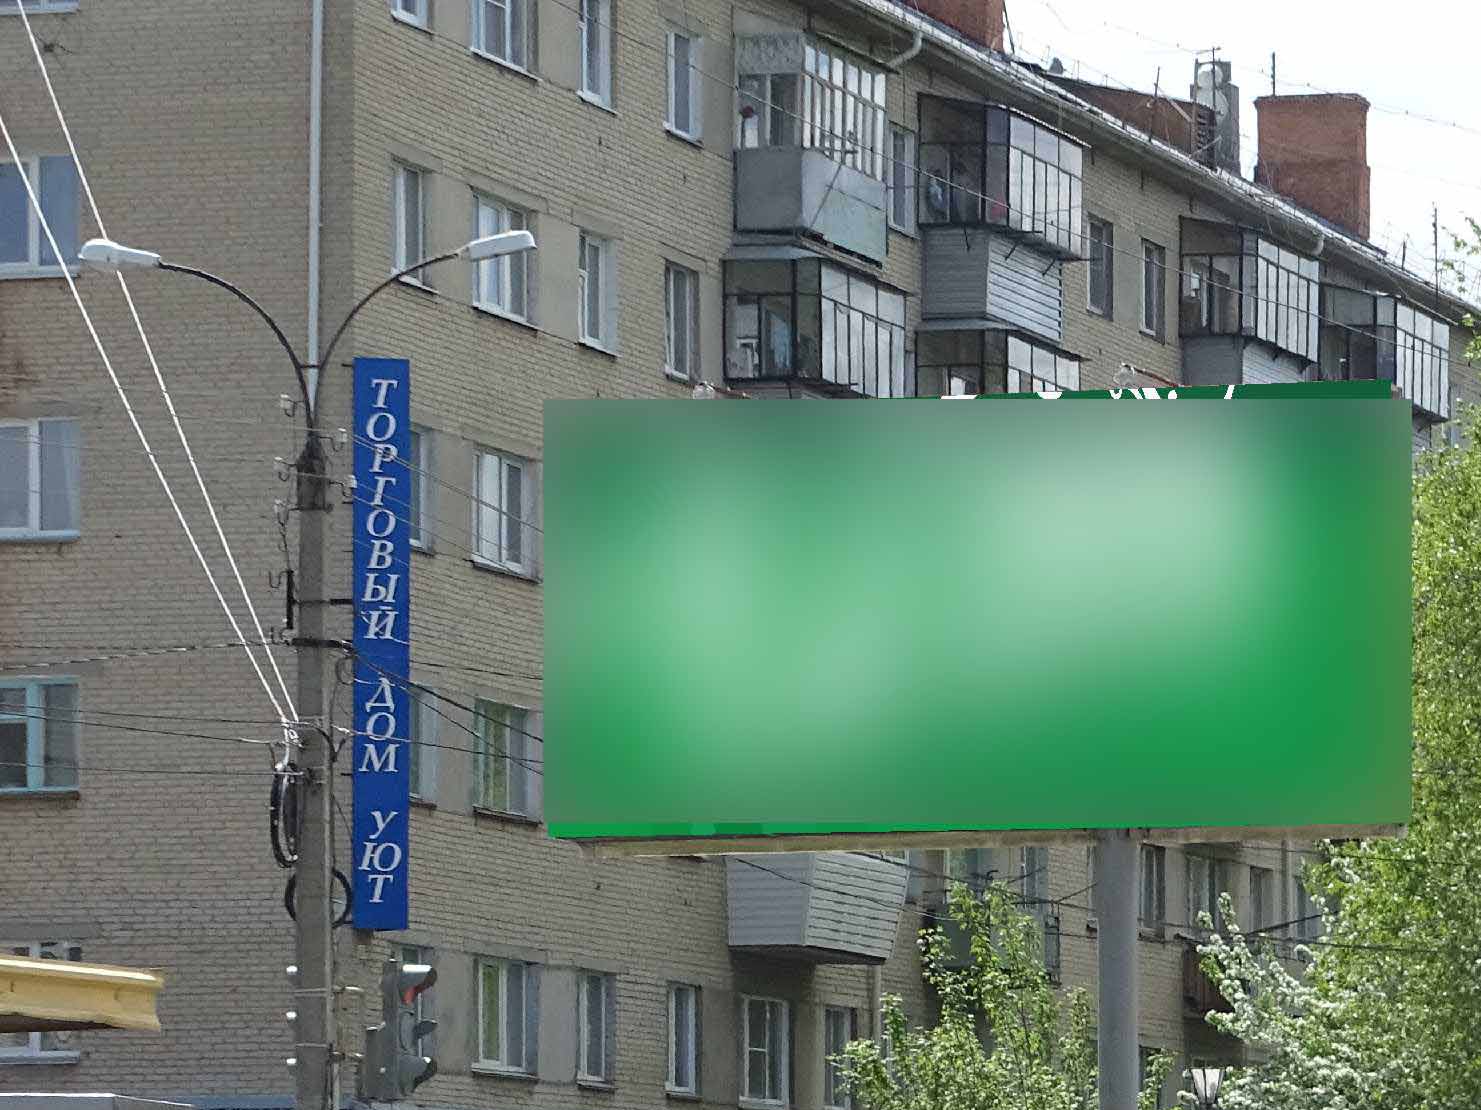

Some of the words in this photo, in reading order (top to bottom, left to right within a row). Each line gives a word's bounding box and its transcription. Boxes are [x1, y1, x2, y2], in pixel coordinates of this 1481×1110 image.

[361, 378, 400, 639] ТОРГОВЫЙ
[358, 677, 400, 772] ДОМ
[358, 810, 402, 903] УЮТ
